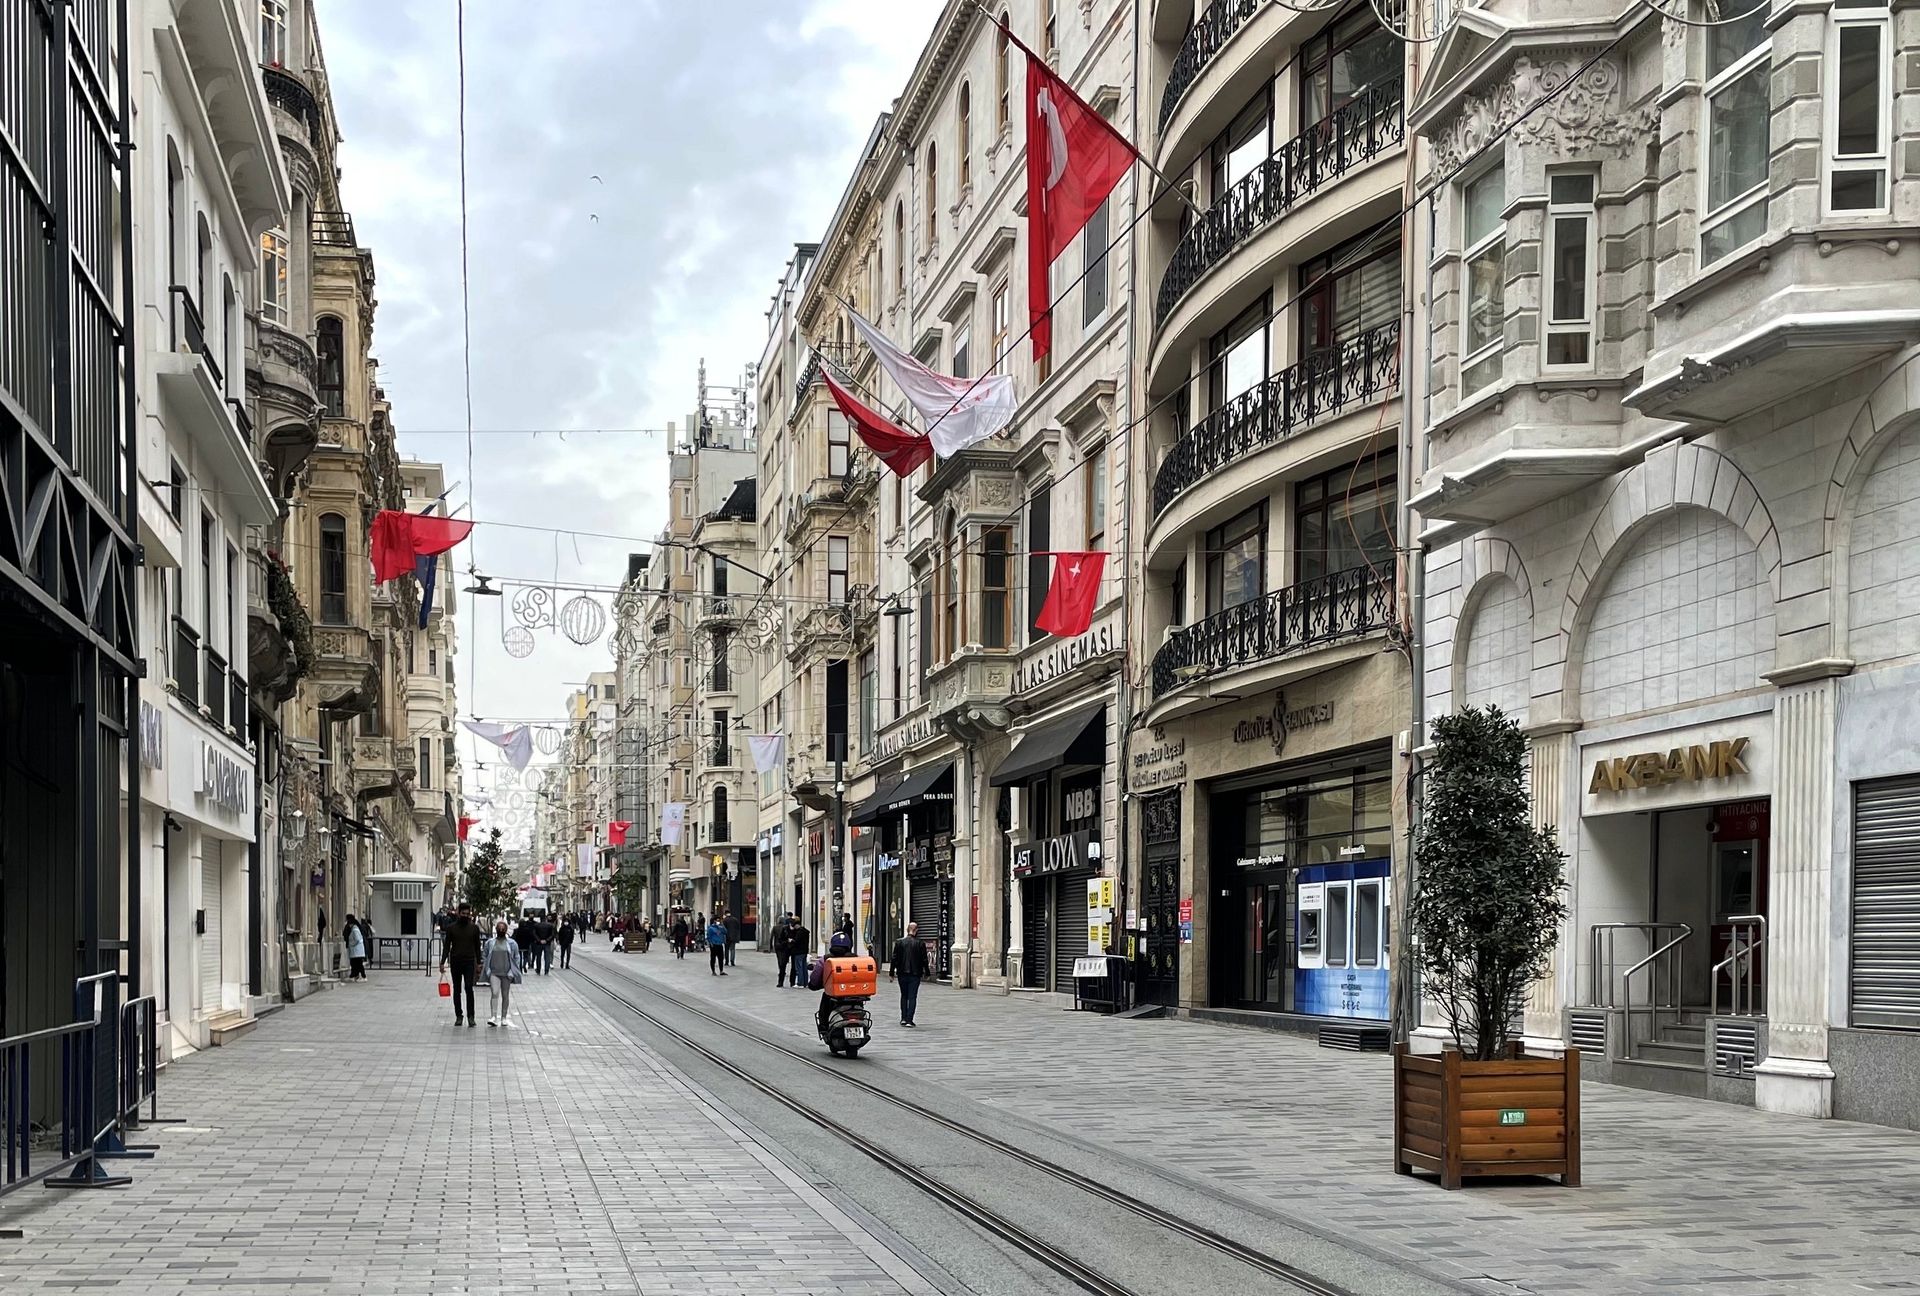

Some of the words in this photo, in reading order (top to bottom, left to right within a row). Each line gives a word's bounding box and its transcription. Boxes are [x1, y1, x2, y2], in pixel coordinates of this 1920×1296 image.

[1010, 659, 1044, 695] ATLAS
[1048, 623, 1115, 680] SİNEMASI
[1588, 736, 1751, 795] AKBANK
[1066, 788, 1096, 822] NBB
[1042, 835, 1079, 872] LOYA
